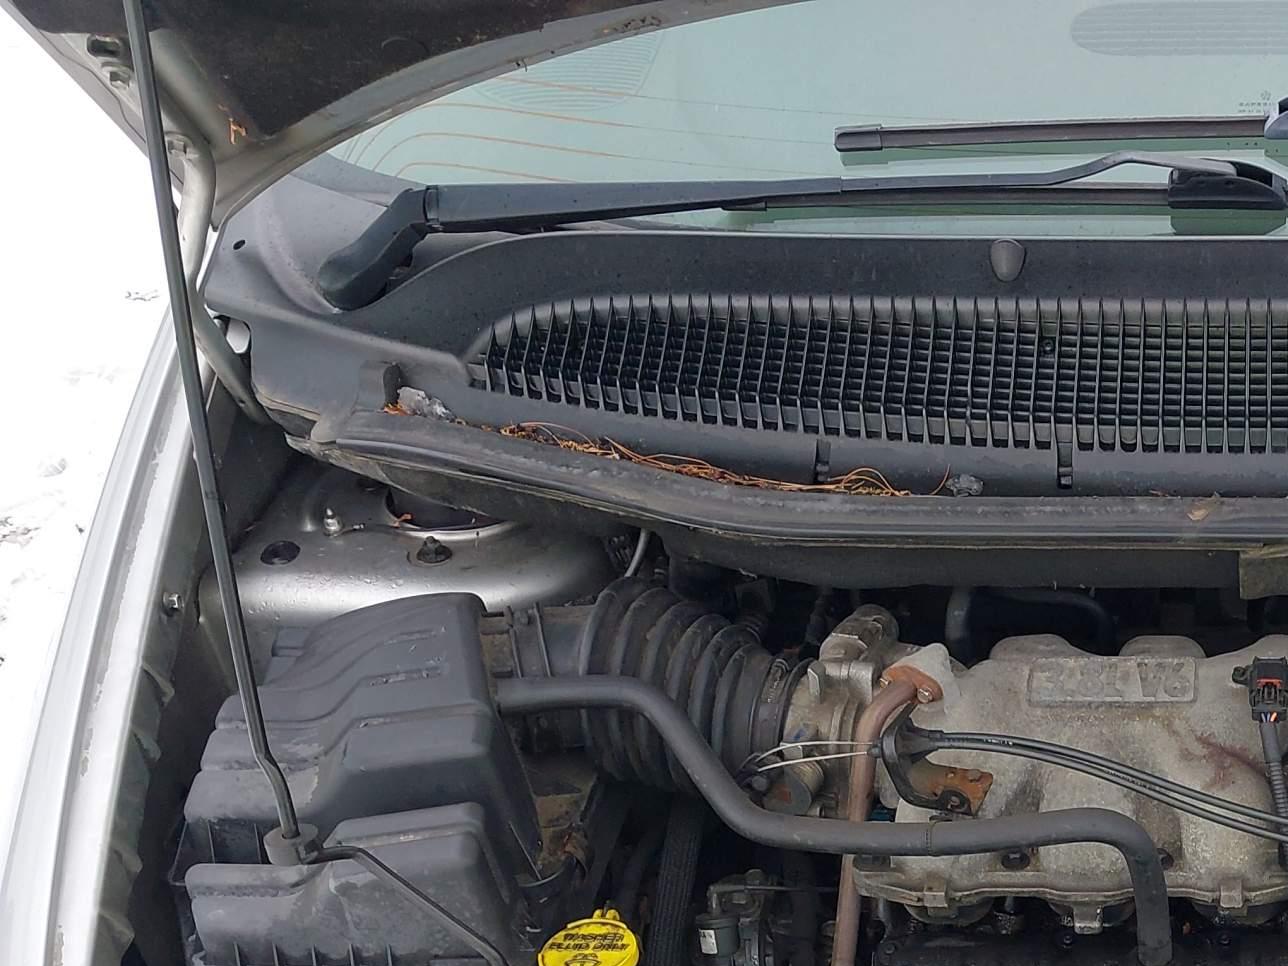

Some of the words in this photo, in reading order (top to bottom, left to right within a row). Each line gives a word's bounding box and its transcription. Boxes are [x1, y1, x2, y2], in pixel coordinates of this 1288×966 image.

[563, 933, 625, 942] WASHER
[548, 942, 590, 952] FLUID
[593, 942, 630, 951] ONLY
